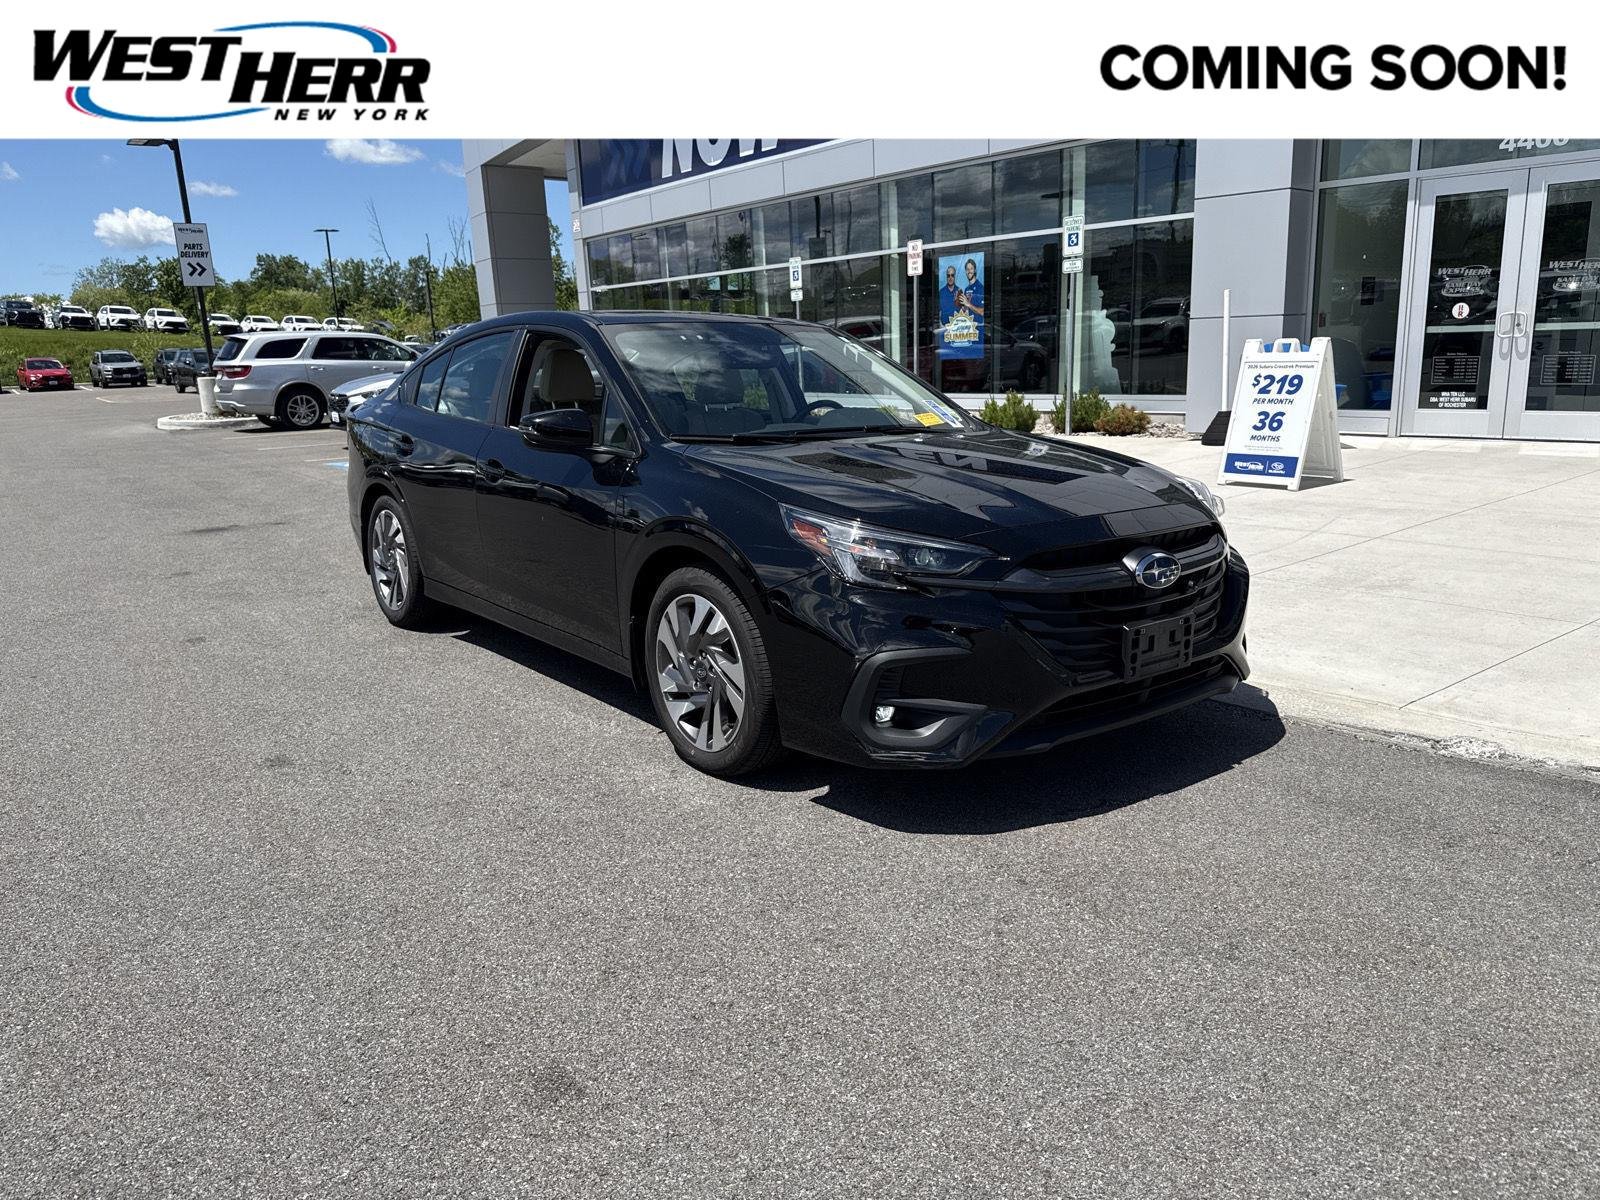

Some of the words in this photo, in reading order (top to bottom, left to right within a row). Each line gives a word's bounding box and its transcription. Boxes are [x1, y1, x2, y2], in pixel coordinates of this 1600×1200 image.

[1549, 260, 1581, 269] WEST
[1579, 261, 1600, 270] HER
[1438, 267, 1466, 275] WEST
[945, 333, 978, 342] SUMMER
[1252, 373, 1304, 395] $219
[1252, 411, 1286, 432] 36
[1250, 434, 1281, 442] MONTHS
